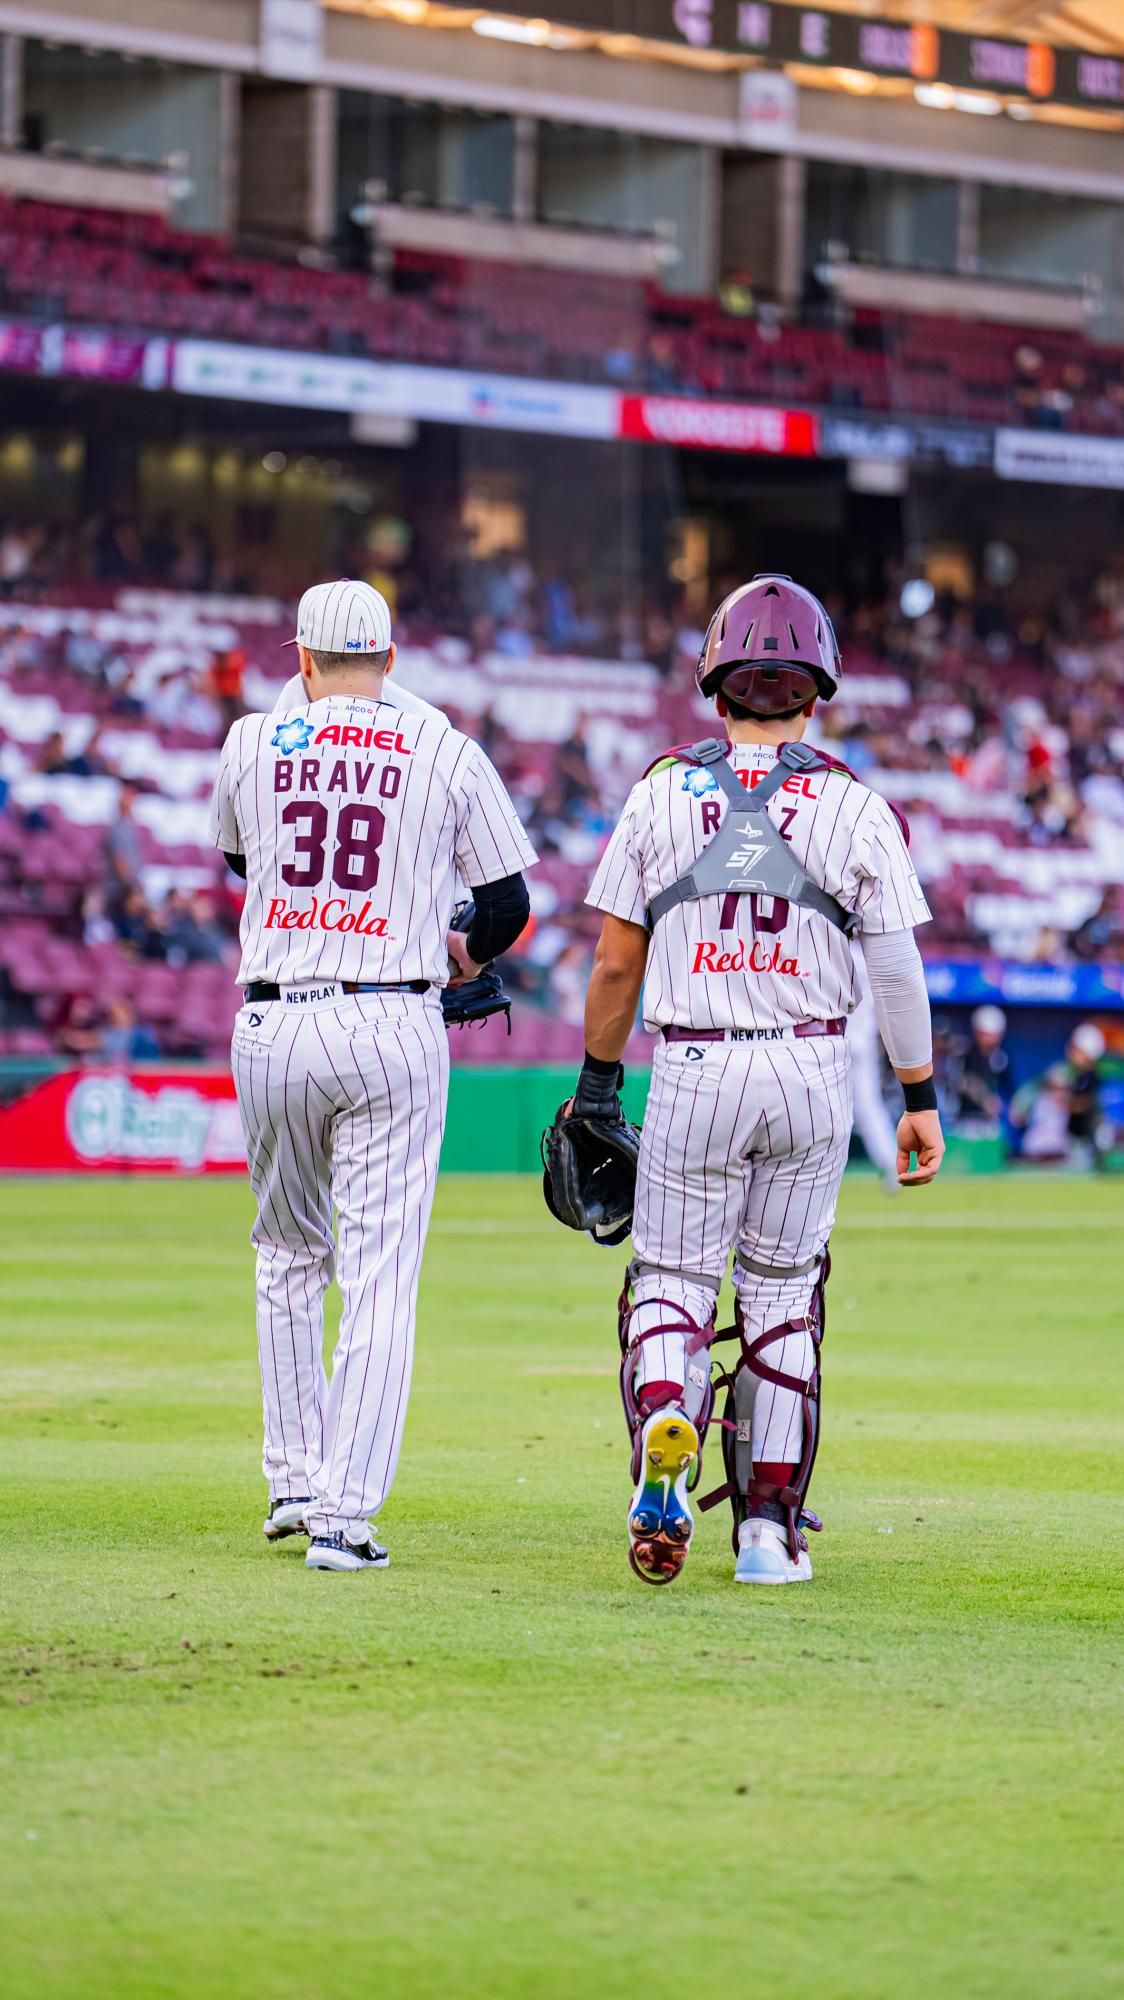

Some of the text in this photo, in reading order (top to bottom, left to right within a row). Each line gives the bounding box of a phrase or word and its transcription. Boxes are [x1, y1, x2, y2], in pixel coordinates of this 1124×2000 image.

[344, 705, 366, 714] ARCO
[314, 725, 412, 756] ARIEL
[274, 758, 402, 799] BRAVO
[281, 800, 387, 893] 38
[263, 896, 389, 937] Red Cola
[690, 938, 747, 975] Red
[286, 985, 337, 1004] NEW PLAY
[730, 1028, 785, 1042] NEW PLAY
